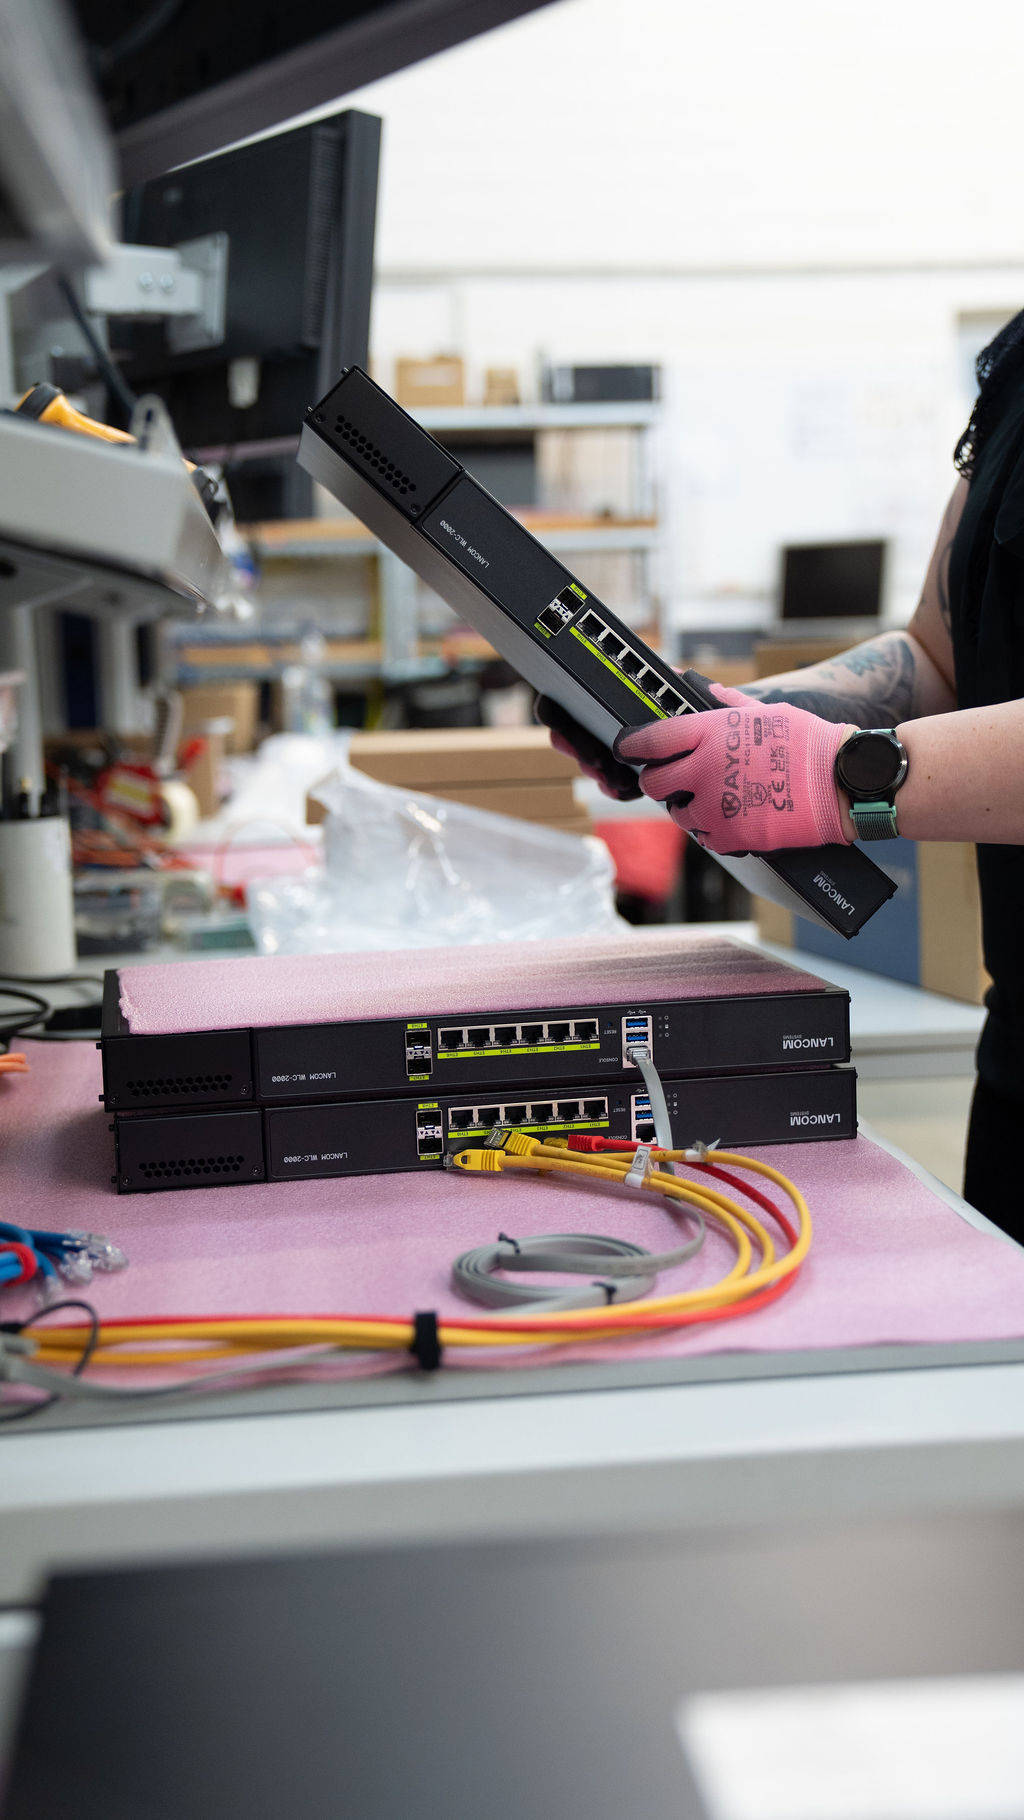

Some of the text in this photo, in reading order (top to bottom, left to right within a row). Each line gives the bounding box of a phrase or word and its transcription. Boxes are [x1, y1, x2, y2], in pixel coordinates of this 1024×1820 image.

[440, 520, 490, 569] LANCOM WLC-2000
[616, 670, 626, 681] ETH4
[635, 689, 646, 700] ETH3
[654, 708, 665, 718] ETH2
[722, 710, 741, 816] KAYGO
[813, 874, 855, 916] LANCOM
[782, 1037, 834, 1050] LANCOM
[271, 1072, 337, 1082] LANCOM WLC-2000
[790, 1113, 841, 1126] LANCOM
[283, 1152, 348, 1163] LANCOM WLC-2000
